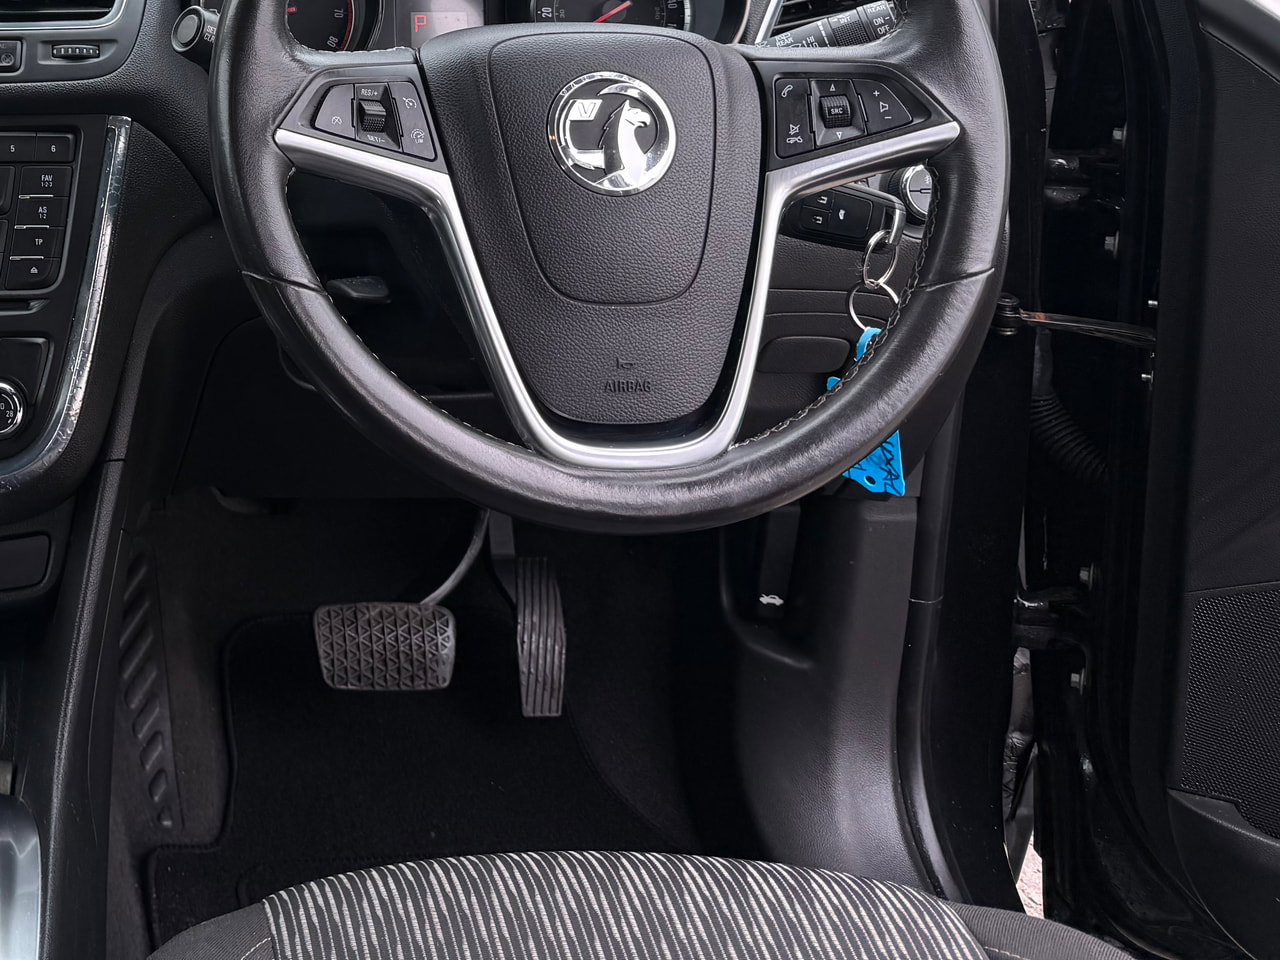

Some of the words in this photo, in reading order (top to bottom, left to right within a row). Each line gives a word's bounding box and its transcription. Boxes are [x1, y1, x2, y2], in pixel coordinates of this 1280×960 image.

[334, 8, 344, 18] 70
[541, 7, 552, 18] 20
[414, 15, 427, 32] P
[327, 35, 339, 48] 80
[604, 380, 651, 393] AIRBAG
[5, 410, 14, 418] 28
